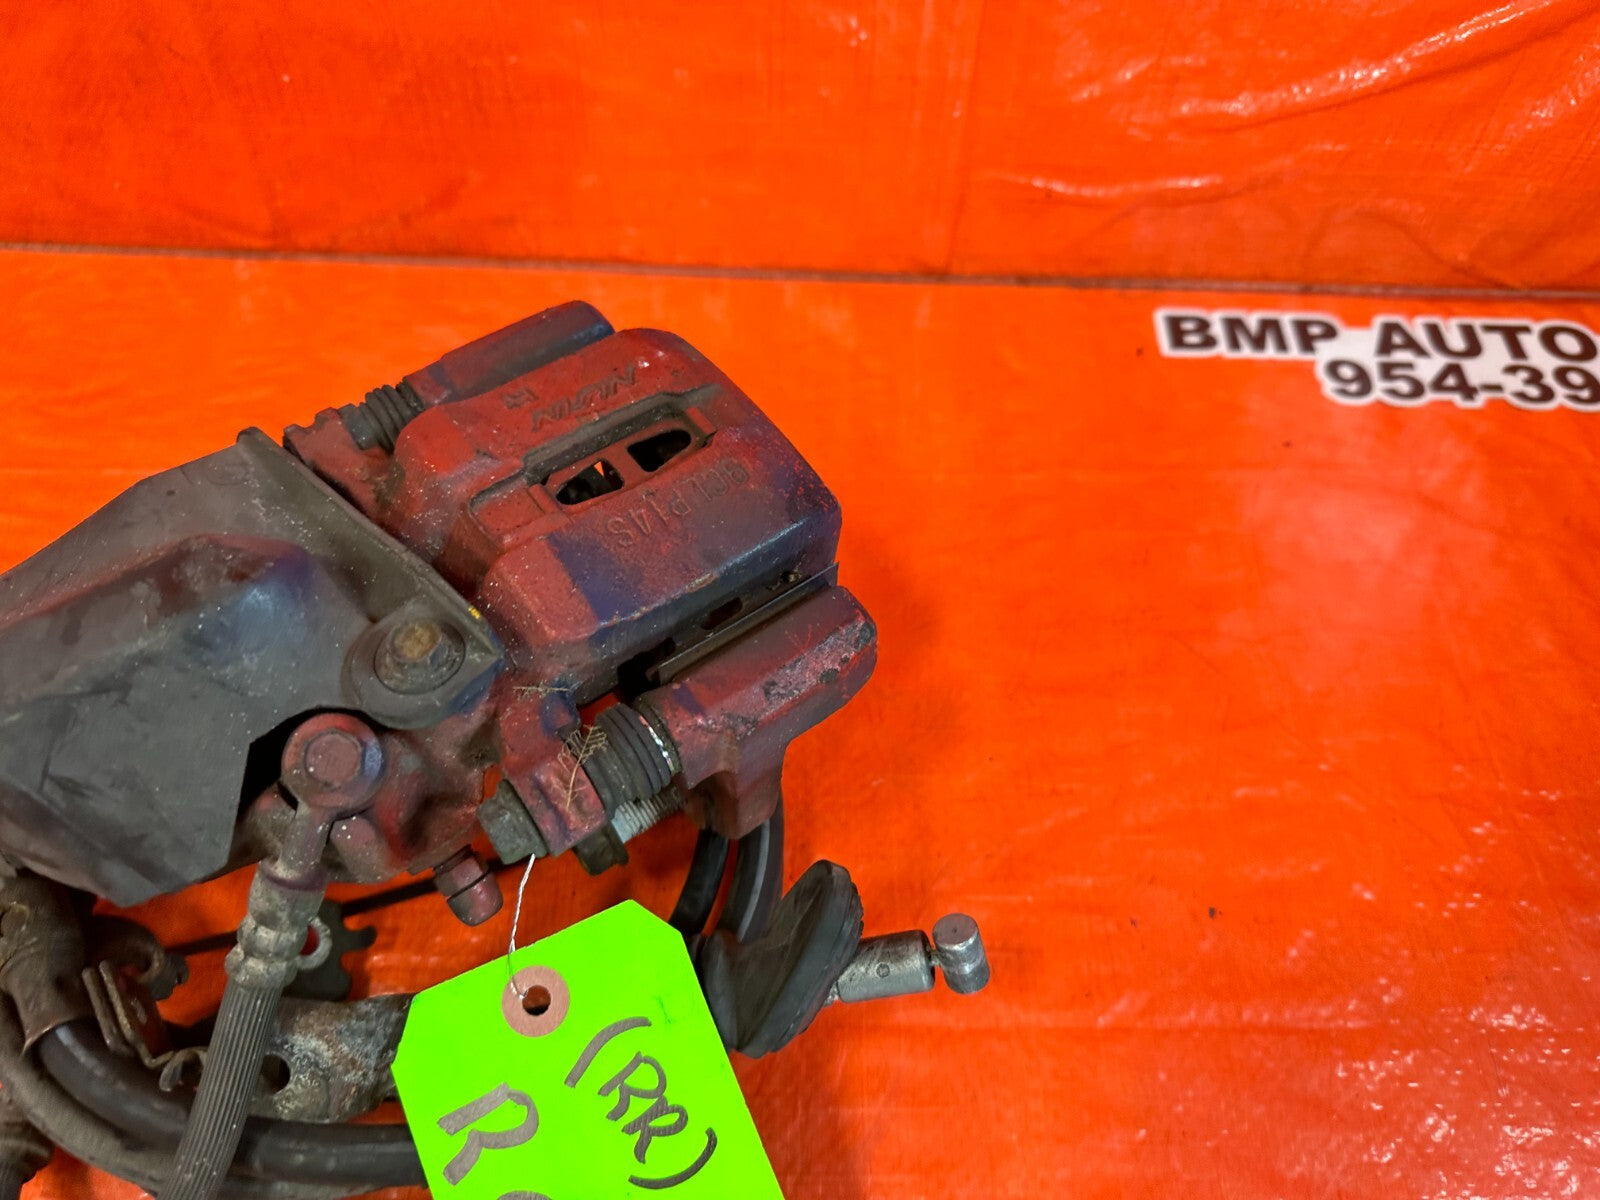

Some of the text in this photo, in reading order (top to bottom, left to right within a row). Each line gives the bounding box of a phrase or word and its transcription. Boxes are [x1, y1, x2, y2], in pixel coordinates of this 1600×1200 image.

[1163, 315, 1599, 362] BMP AUTO
[1325, 360, 1600, 404] 954-39
